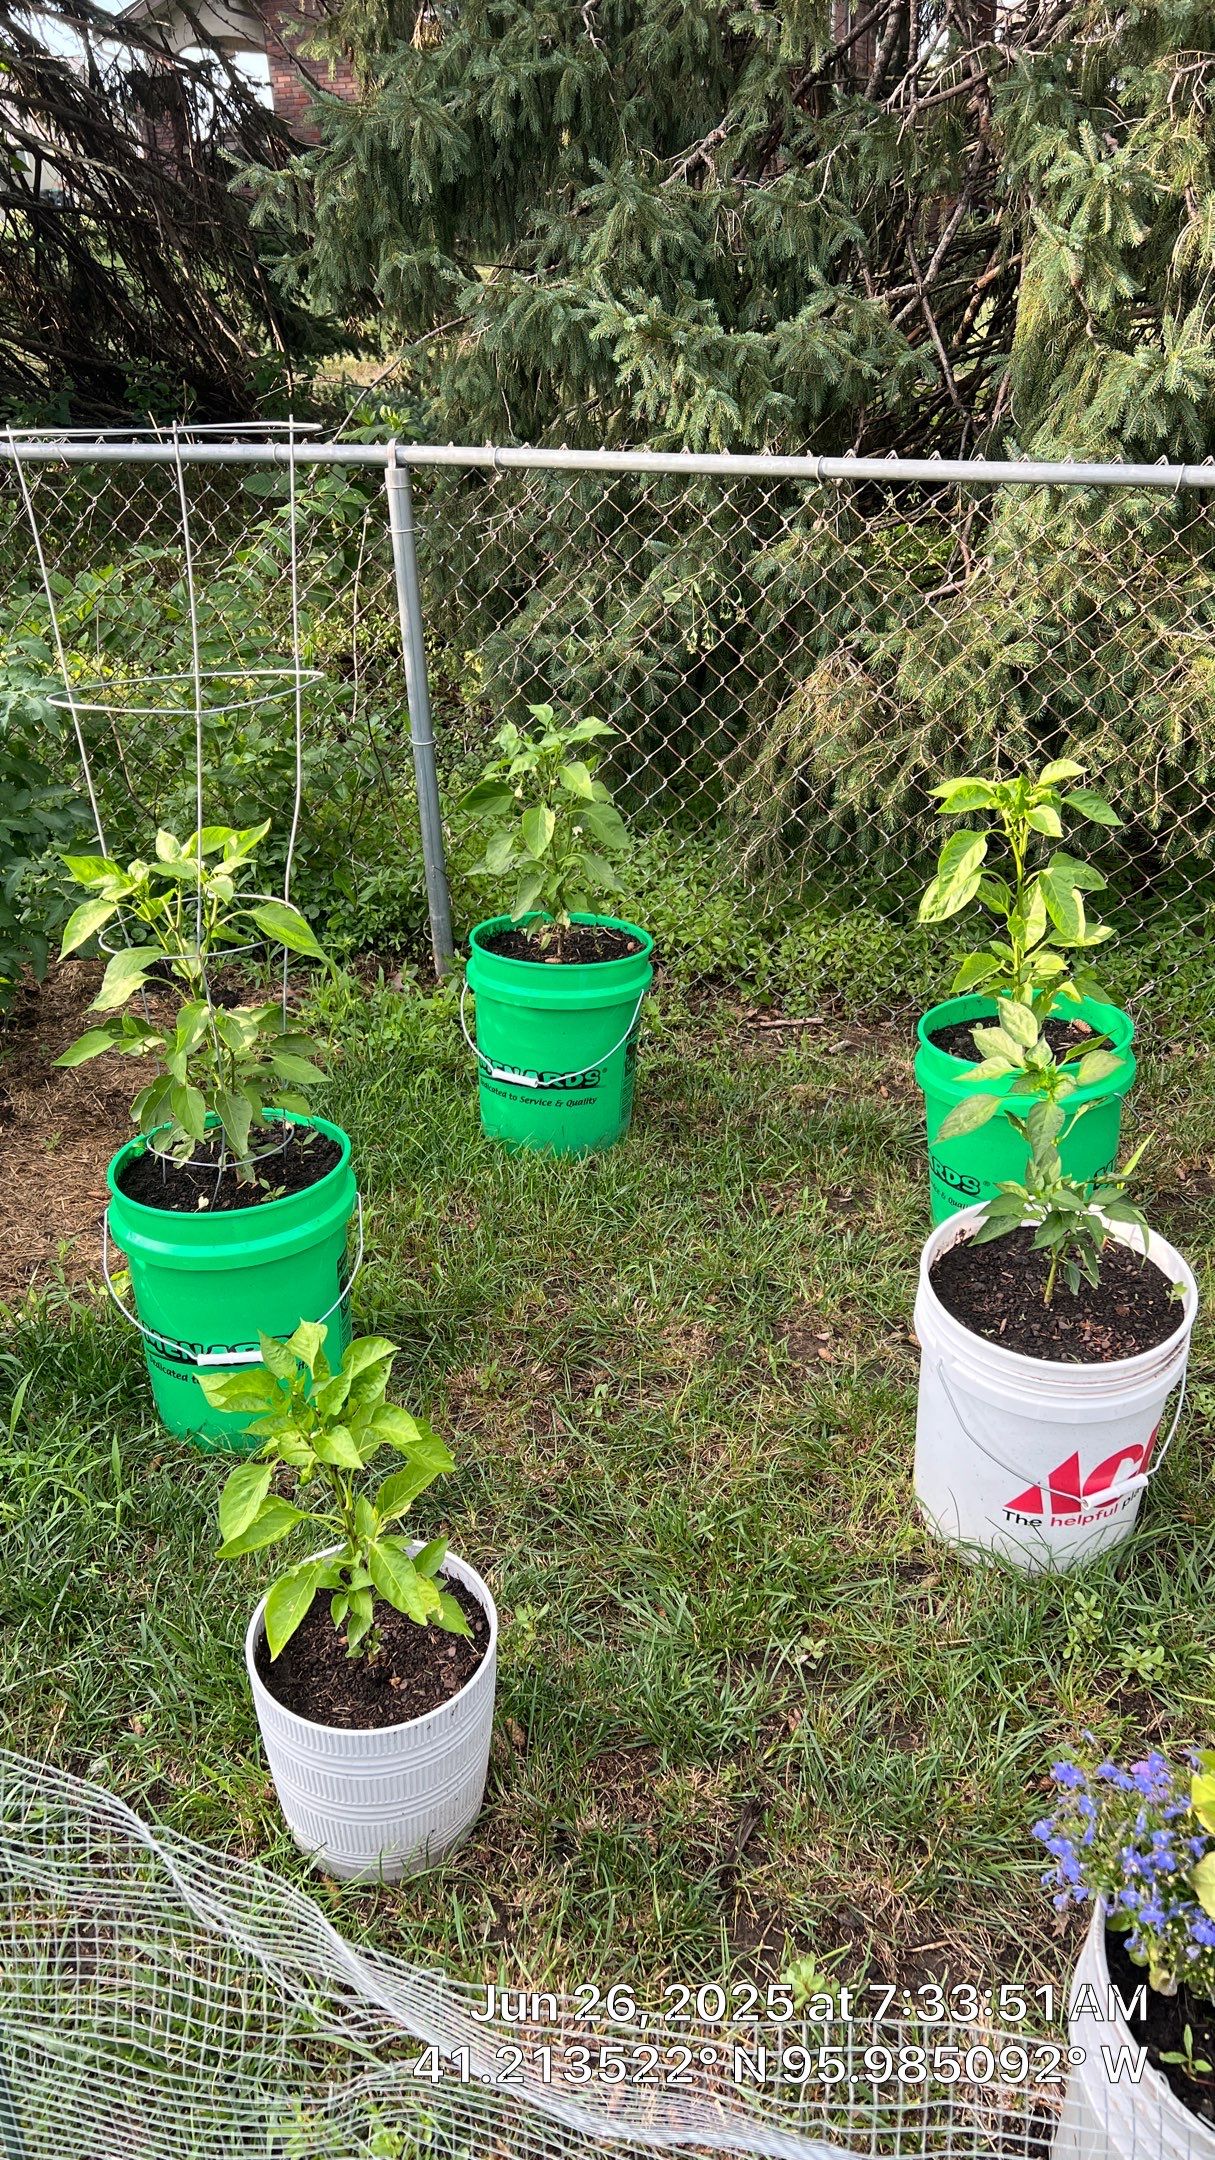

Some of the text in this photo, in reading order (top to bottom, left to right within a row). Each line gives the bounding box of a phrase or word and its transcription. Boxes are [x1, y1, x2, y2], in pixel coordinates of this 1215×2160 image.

[509, 1092, 518, 1101] to
[520, 1095, 552, 1107] Service
[555, 1099, 563, 1107] &
[566, 1097, 597, 1108] Quality
[1003, 1420, 1160, 1515] AC
[1002, 1508, 1043, 1527] The
[1050, 1504, 1119, 1527] helpful
